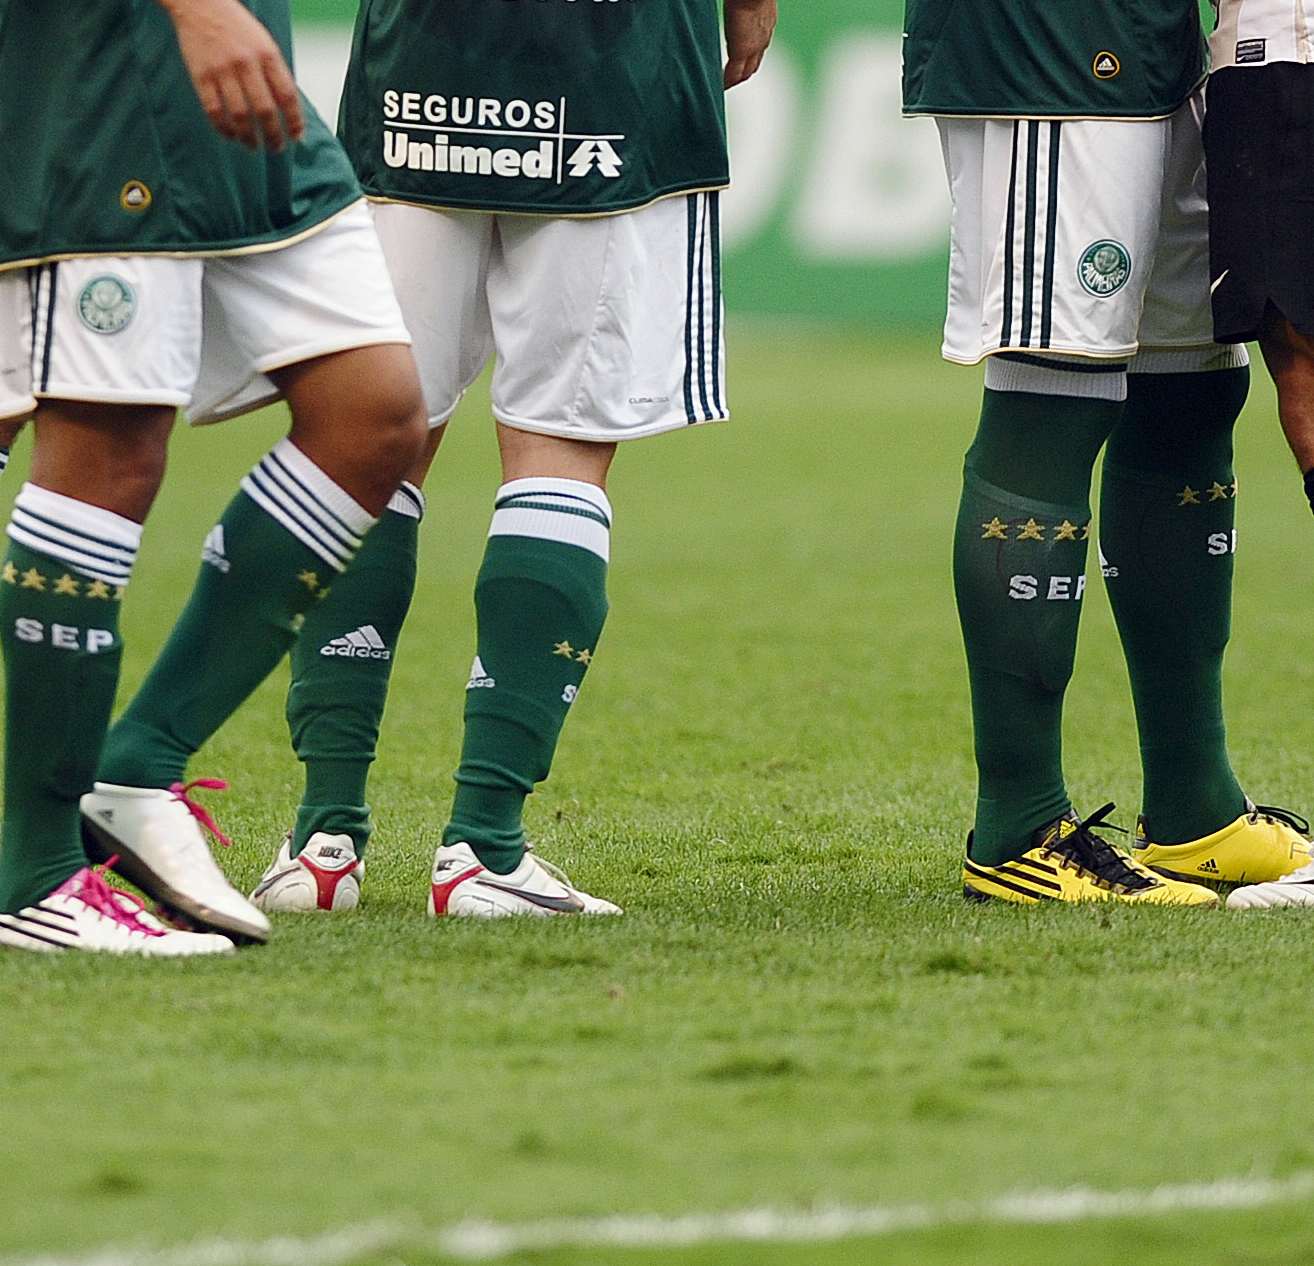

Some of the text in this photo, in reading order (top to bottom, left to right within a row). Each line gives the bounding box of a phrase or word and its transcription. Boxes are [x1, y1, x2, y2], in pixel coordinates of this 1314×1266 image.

[383, 90, 556, 129] SEGUROS
[383, 130, 554, 179] Unimed
[15, 617, 115, 654] SEP
[320, 644, 391, 660] adidas
